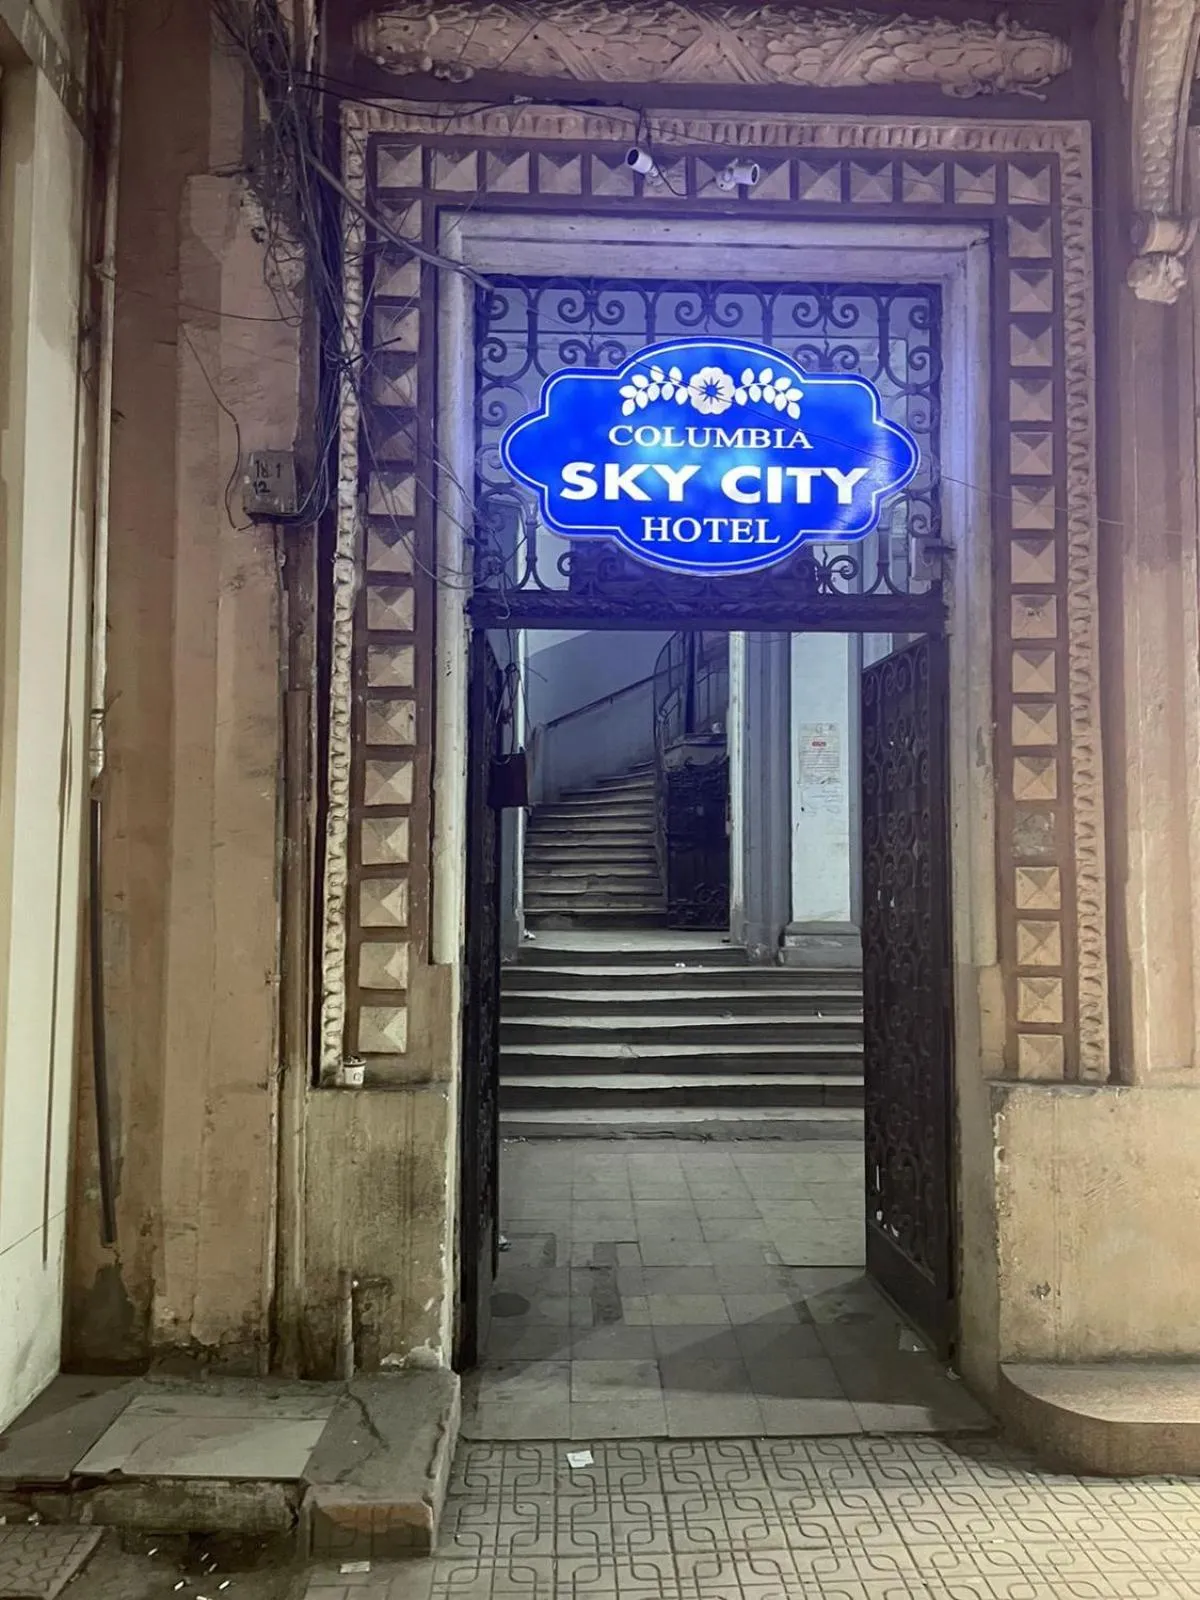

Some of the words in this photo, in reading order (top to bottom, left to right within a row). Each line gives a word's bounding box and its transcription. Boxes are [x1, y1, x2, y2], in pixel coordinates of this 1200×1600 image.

[608, 425, 813, 450] COLUMBIA
[561, 461, 701, 502] SKY
[721, 465, 870, 505] CITY
[641, 516, 780, 544] HOTEL
